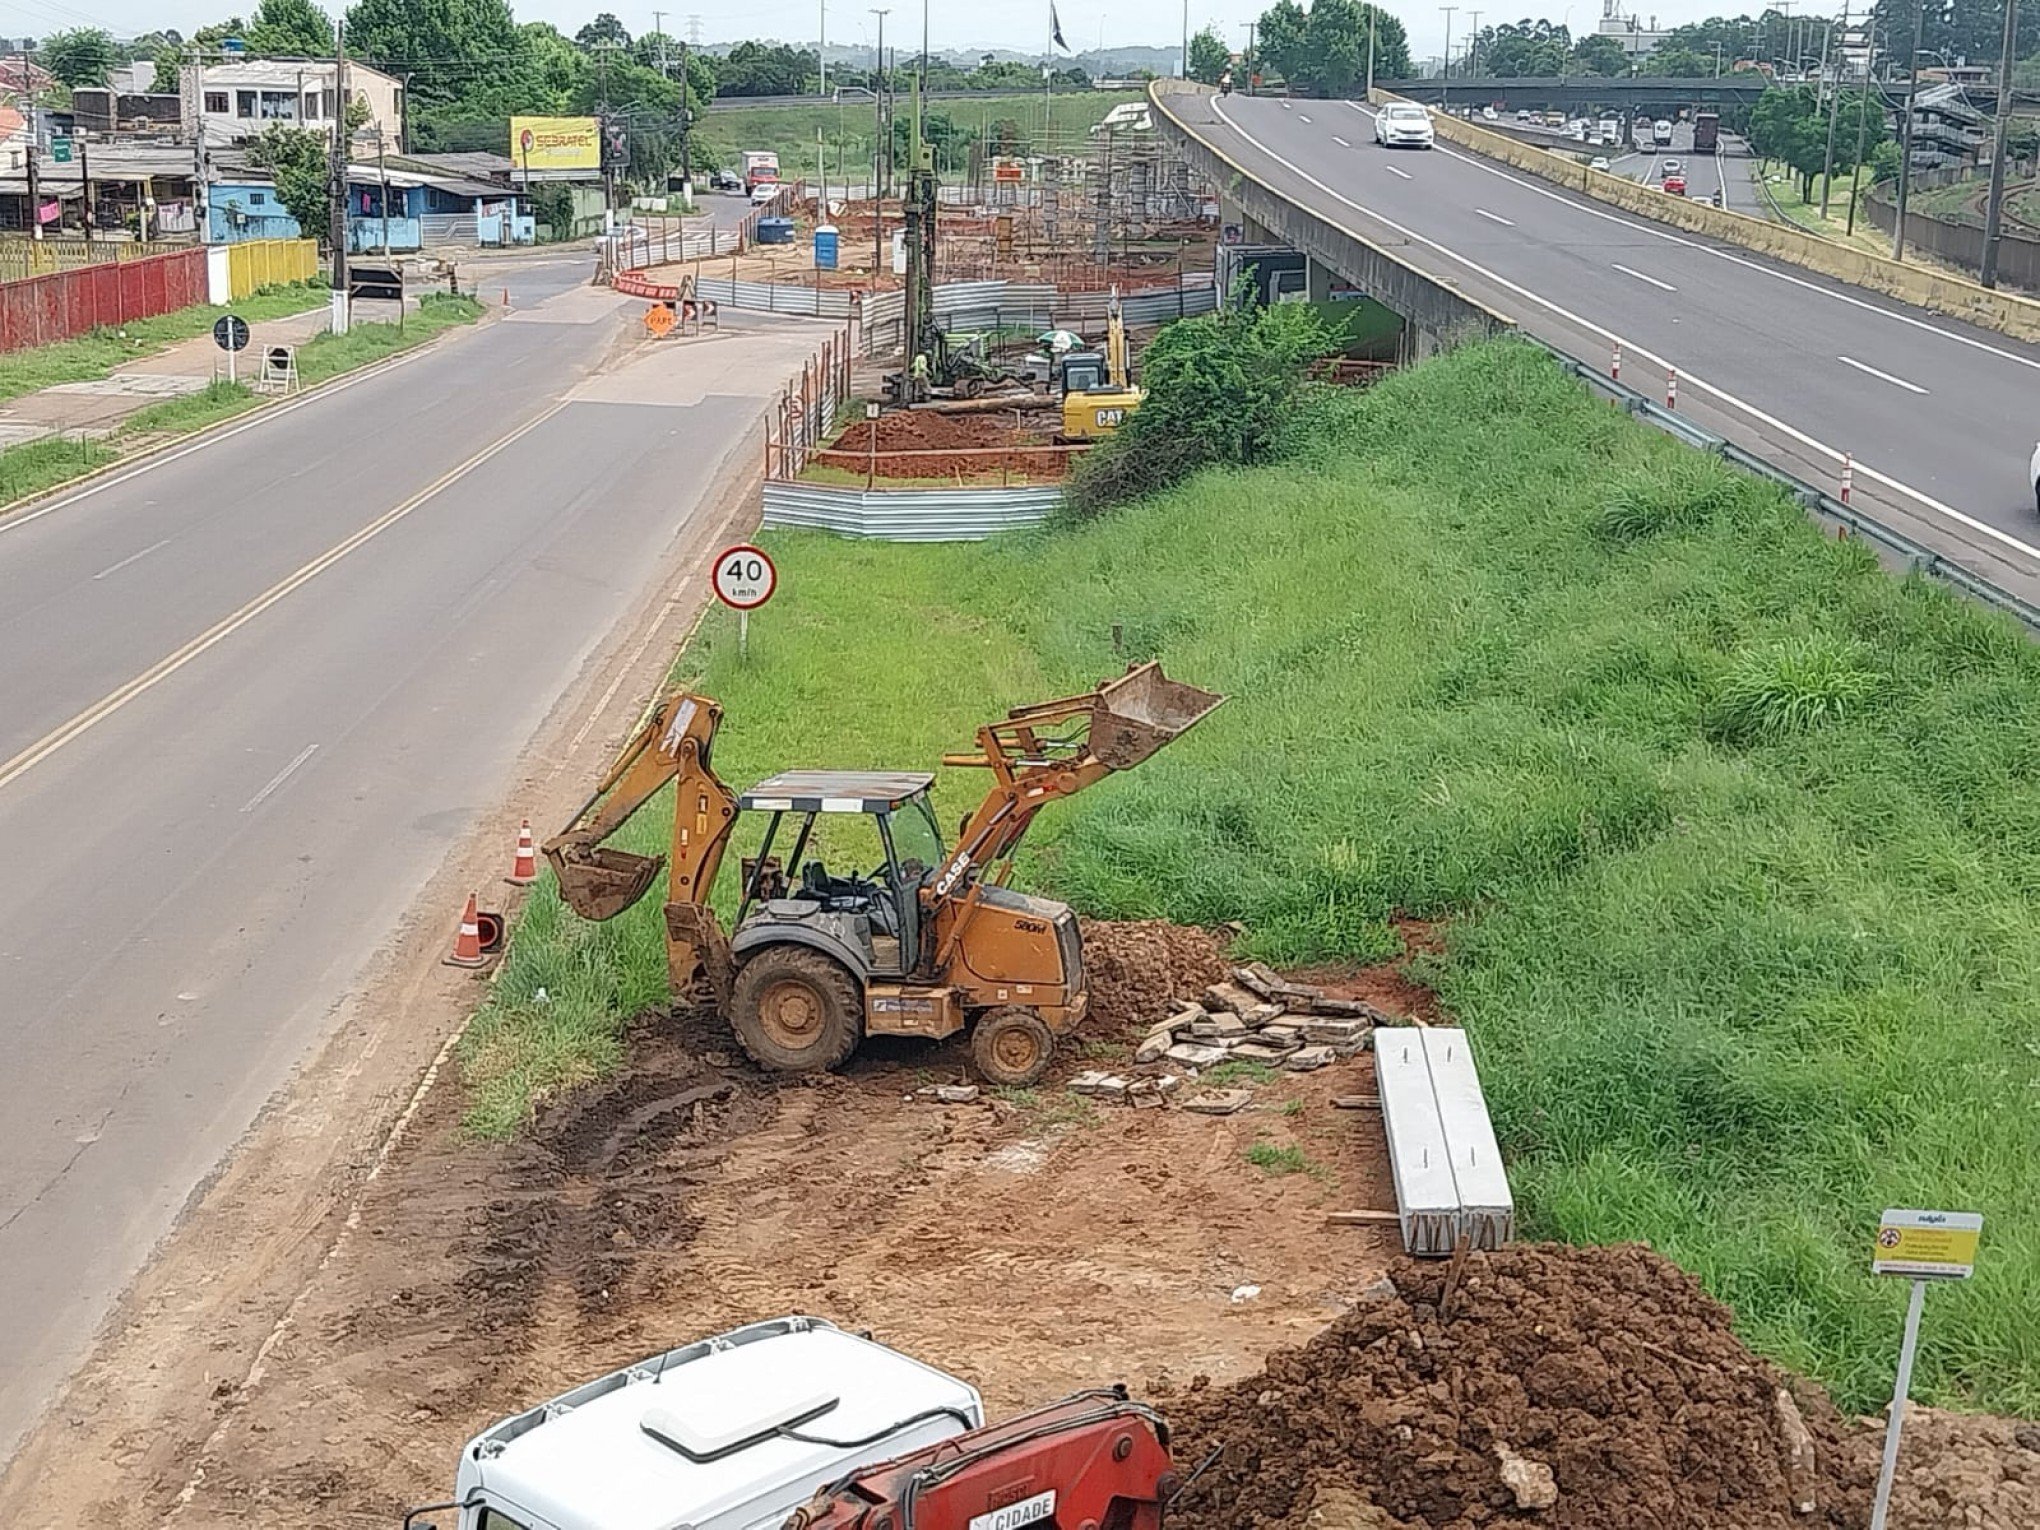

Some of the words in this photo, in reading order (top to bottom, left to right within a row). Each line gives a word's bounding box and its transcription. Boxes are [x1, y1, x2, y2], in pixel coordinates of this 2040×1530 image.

[1097, 409, 1123, 427] CAT
[726, 560, 762, 581] 40
[732, 588, 757, 597] km/h
[936, 851, 970, 896] CASE
[995, 1498, 1051, 1530] CIDADE
